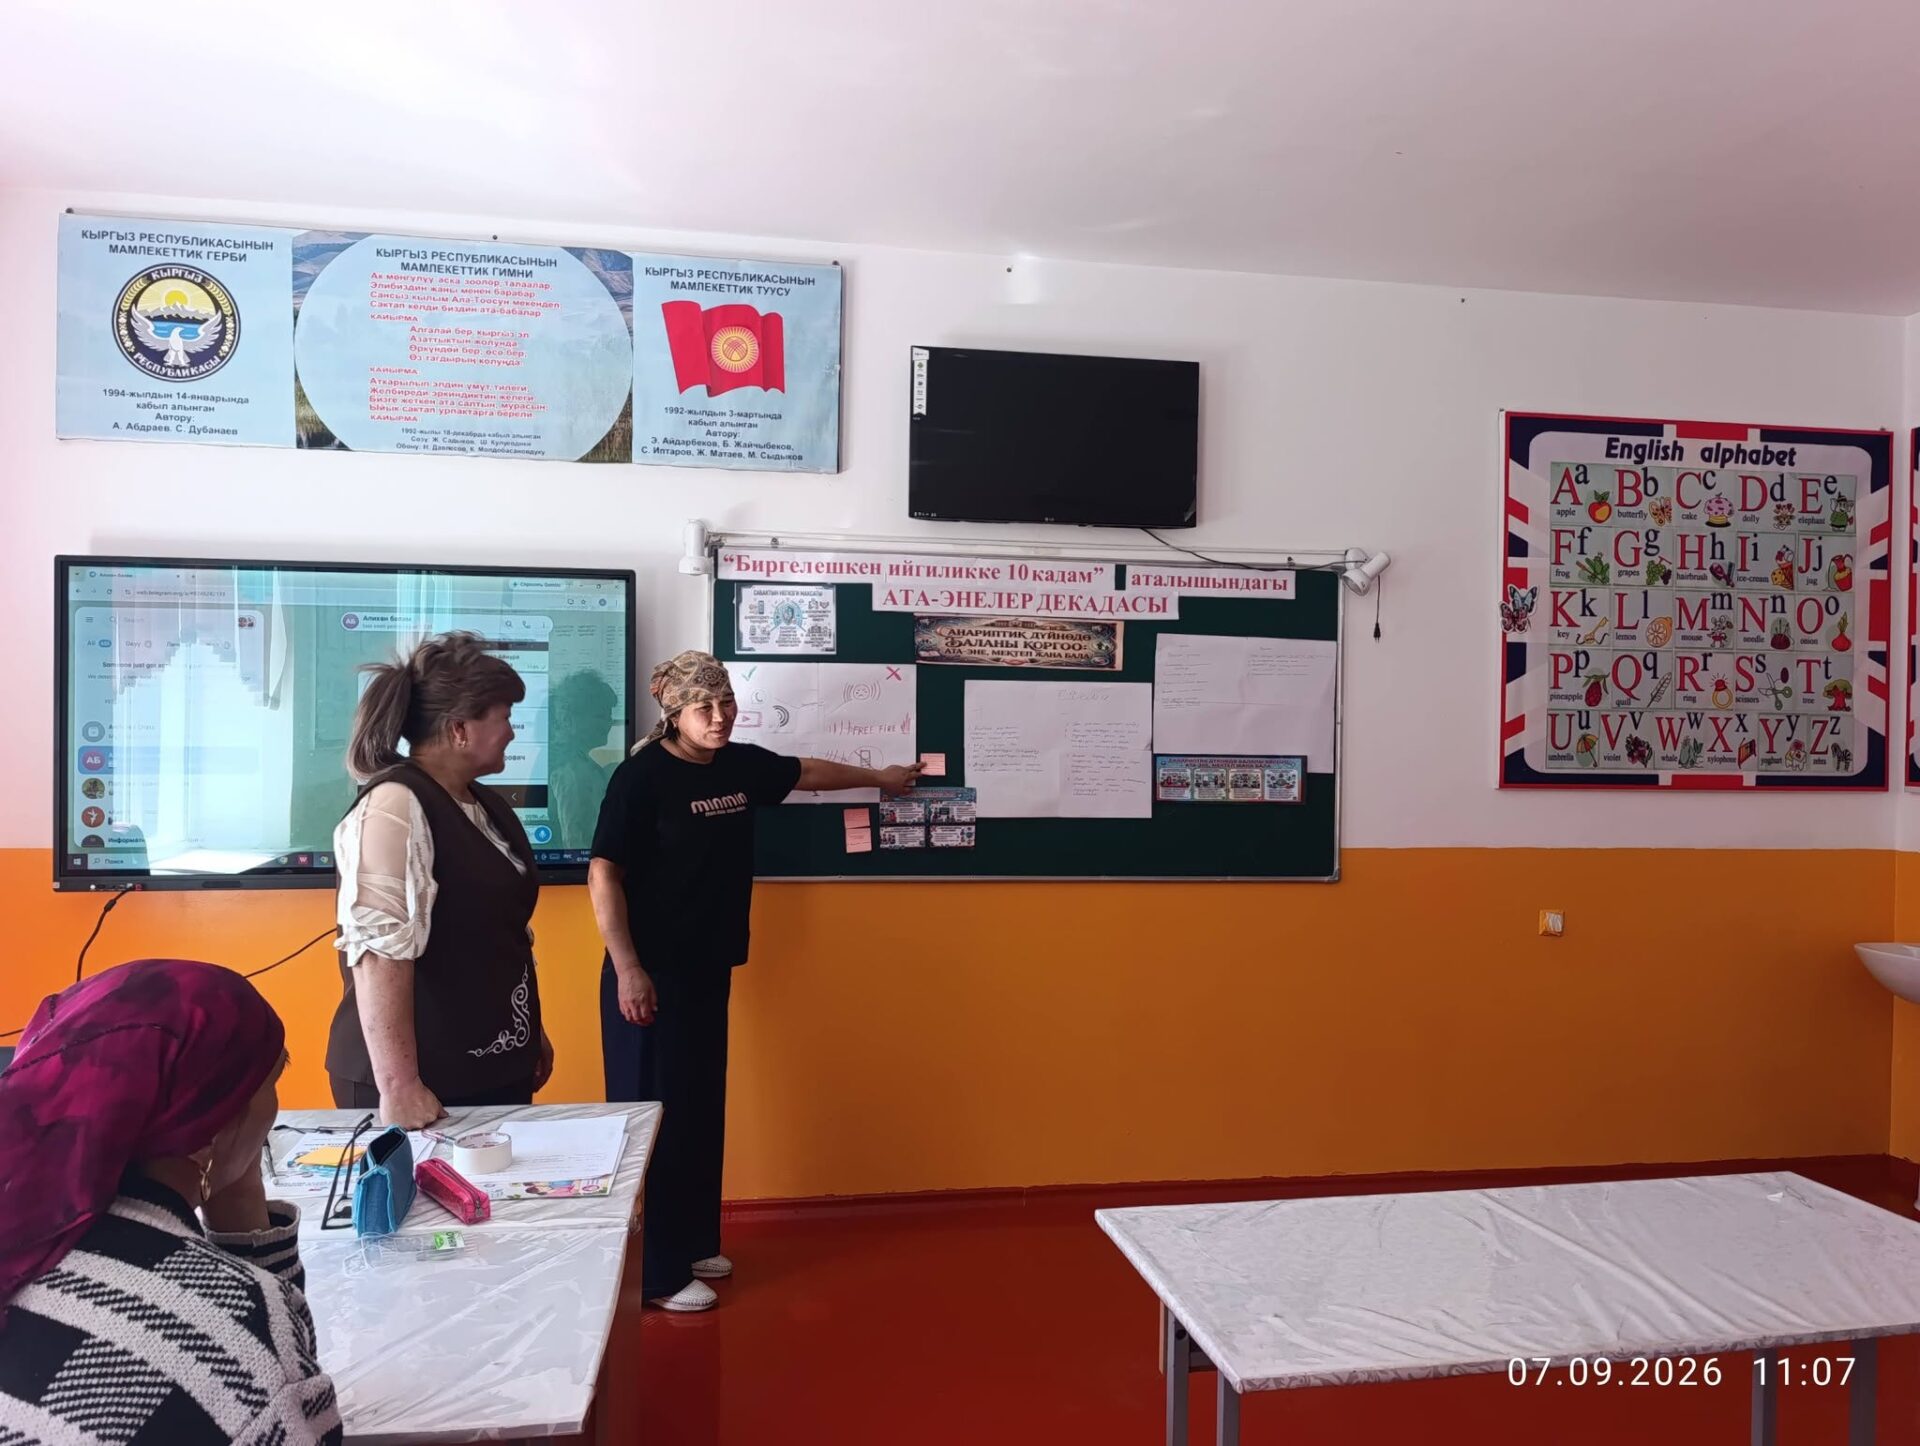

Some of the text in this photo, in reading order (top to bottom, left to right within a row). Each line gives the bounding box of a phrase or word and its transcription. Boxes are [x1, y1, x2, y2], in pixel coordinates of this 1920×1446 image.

[81, 230, 274, 251] КЫРГЫЗ РЕСПУБЛИКАСЫНЫН
[108, 244, 247, 262] МАМЛЕКЕТТИК ГЕРБИ
[376, 248, 557, 268] КЫРГЫЗ РЕСПУБЛИКАСЫНЫН
[150, 267, 203, 283] КЫРГЫЗ
[400, 262, 533, 279] МАМЛЕКЕТТИК ГИМНИ
[645, 267, 816, 286] КЫРГЫЗ РЕСПУБЛИКАСЫНЫН
[670, 280, 791, 297] МАМЛЕКЕТТИК ТУУСУ
[133, 352, 222, 378] РЕСПУБЛИКАСЫ
[136, 401, 215, 413] кабыл алынган
[688, 418, 718, 428] кабыл
[1605, 437, 1797, 468] English alphabet
[1556, 508, 1576, 518] apple
[1617, 510, 1648, 520] butterfly
[1742, 514, 1760, 524] dolly
[1798, 517, 1825, 526] elephant
[888, 559, 1001, 580] ийгиликке
[1131, 573, 1288, 592] аталышындагы
[1555, 568, 1570, 579] frog
[1617, 569, 1640, 577] grapes
[1676, 572, 1708, 581] hairbrush
[1737, 575, 1769, 583] ice-cream
[1806, 576, 1818, 586] jug
[1557, 630, 1570, 640] key
[1615, 632, 1637, 641] lemon
[1681, 634, 1702, 642] mouse
[1743, 635, 1765, 643] needle
[1800, 637, 1818, 645] onion
[1065, 652, 1090, 660] БАЛА
[1550, 693, 1583, 702] pineapple
[1683, 694, 1696, 704] ring
[1604, 753, 1621, 762] violet
[1661, 753, 1678, 762] whale
